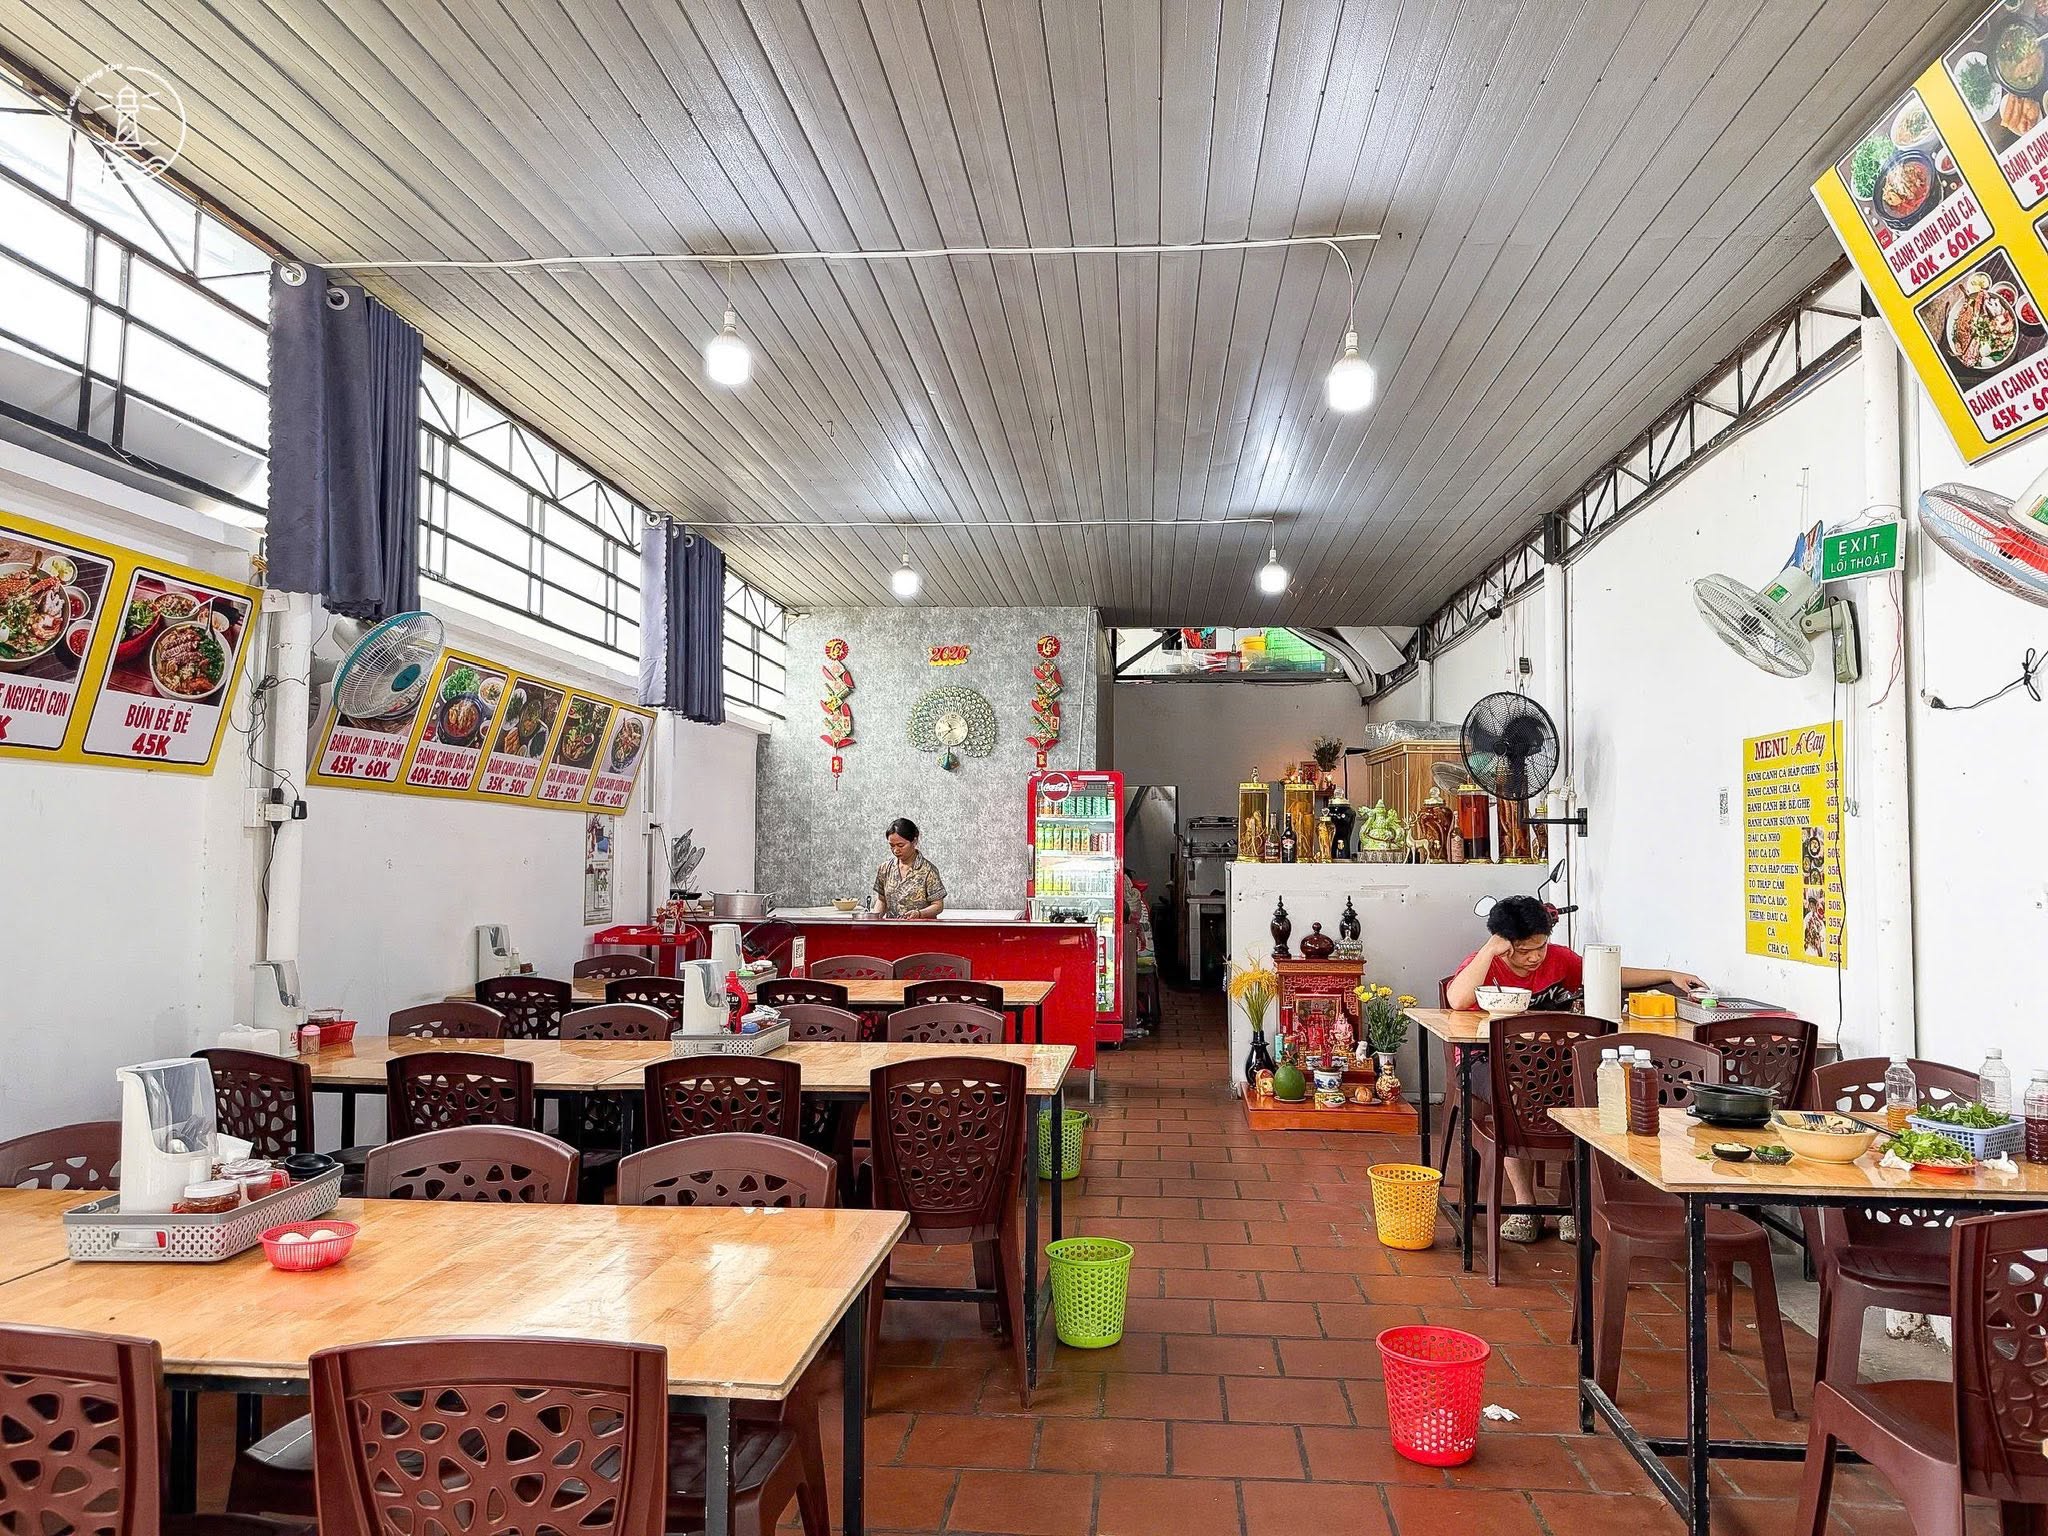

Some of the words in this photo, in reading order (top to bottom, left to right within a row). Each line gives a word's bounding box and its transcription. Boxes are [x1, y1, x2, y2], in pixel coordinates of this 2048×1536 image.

[2003, 155, 2033, 184] BÁNH
[1889, 246, 1917, 274] BÁNH
[1913, 222, 1942, 255] CANH
[1937, 205, 1961, 236] ĐẦU
[1957, 192, 1977, 221] CÁ
[1910, 254, 1940, 286] 40K
[1946, 223, 1980, 259] 60K
[1968, 390, 2005, 417] BÁNH
[2001, 366, 2039, 399] CANH
[1991, 404, 2023, 431] 45K
[1838, 534, 1880, 556] EXIT
[1830, 555, 1847, 573] LỐI
[1850, 552, 1888, 569] THOÁT
[930, 645, 969, 662] 2026
[2, 683, 48, 713] NGUYÊN
[46, 691, 71, 718] CON
[124, 701, 154, 729] BÚN
[132, 732, 172, 756] 45K
[329, 731, 351, 752] BÁNH
[350, 736, 371, 755] CANH
[1754, 736, 1789, 761] MENU
[1805, 730, 1826, 758] Cay
[330, 755, 357, 774] 45K
[364, 760, 392, 778] 60K
[416, 745, 436, 766] BÁNH
[435, 750, 453, 768] CANH
[468, 752, 478, 771] CÁ
[410, 766, 471, 788] 40K-50K-60K
[486, 776, 504, 791] 35K
[509, 779, 527, 794] 50K
[544, 784, 560, 799] 35K
[563, 786, 579, 801] 50K
[1828, 900, 1841, 910] 50K
